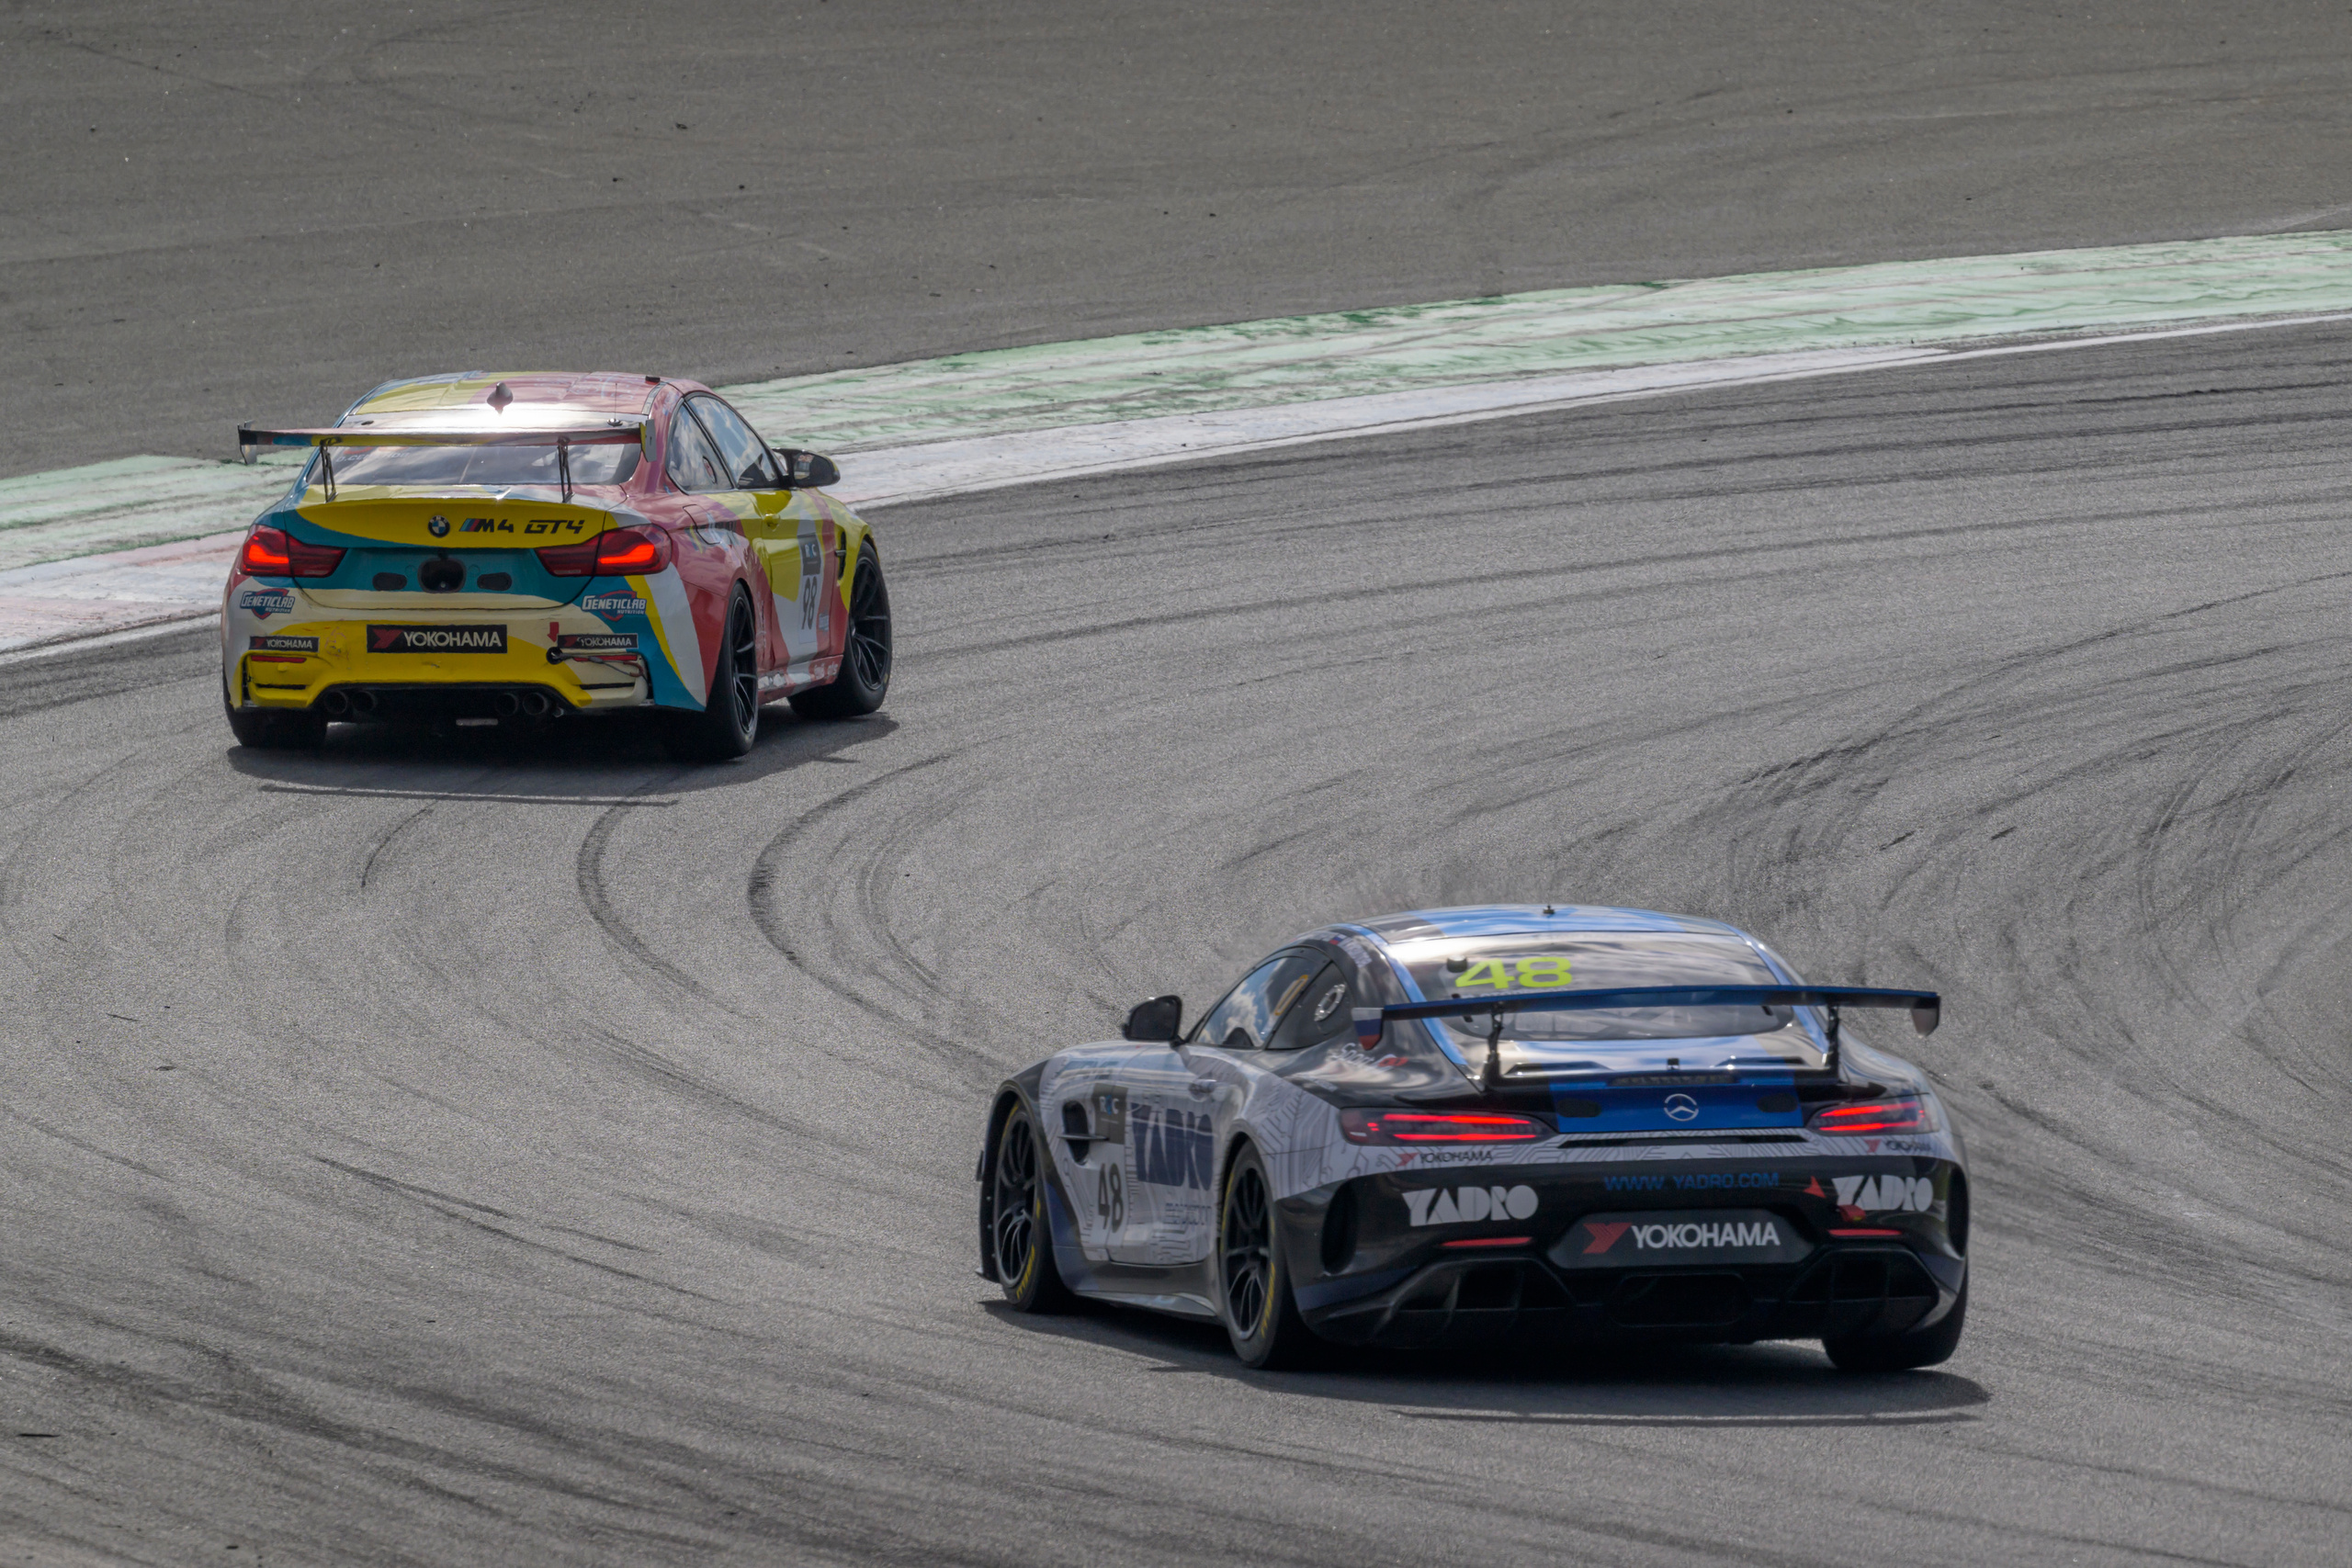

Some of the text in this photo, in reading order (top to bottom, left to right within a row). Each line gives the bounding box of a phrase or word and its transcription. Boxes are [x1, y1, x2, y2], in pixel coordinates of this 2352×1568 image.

[475, 518, 585, 535] M4 GT4
[241, 592, 294, 608] GENETICLAB
[582, 595, 647, 610] GENETICLAB
[801, 576, 818, 630] 98
[266, 638, 312, 649] YOKOHAMA
[403, 631, 502, 648] YOKOHAMA
[577, 636, 632, 647] YOKOHAMA
[1454, 956, 1573, 989] 48
[1419, 1149, 1493, 1164] YOKOHAMA
[1098, 1162, 1124, 1234] 48
[1831, 1174, 1934, 1213] YADRO
[1401, 1184, 1539, 1227] YADRO
[1631, 1221, 1781, 1250] YOKOHAMA
